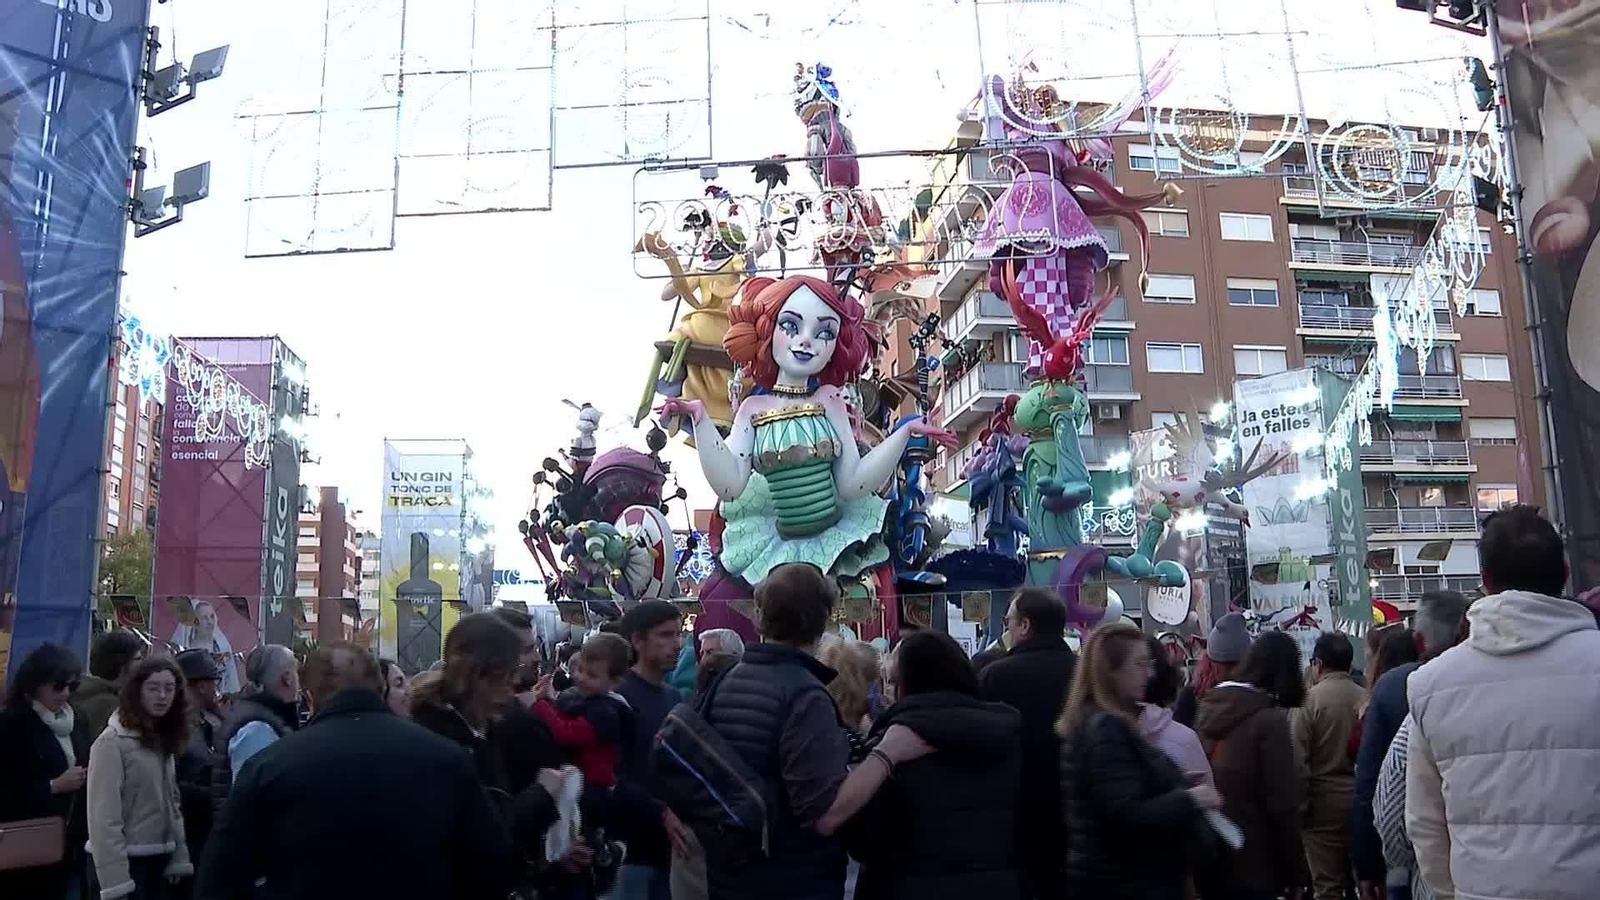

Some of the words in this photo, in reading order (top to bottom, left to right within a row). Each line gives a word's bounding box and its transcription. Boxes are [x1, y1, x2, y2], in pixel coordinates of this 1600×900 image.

[1241, 410, 1257, 423] Ja
[1242, 425, 1260, 437] en
[1264, 417, 1311, 434] falles
[172, 432, 241, 444] convencia
[171, 449, 219, 460] esencial
[391, 472, 417, 482] UN
[420, 472, 452, 482] GIN
[1136, 460, 1178, 482] TURI
[390, 485, 431, 493] TONIC
[434, 485, 452, 493] DE
[390, 496, 452, 507] TRACA
[270, 486, 289, 617] teika
[1340, 488, 1361, 606] teika
